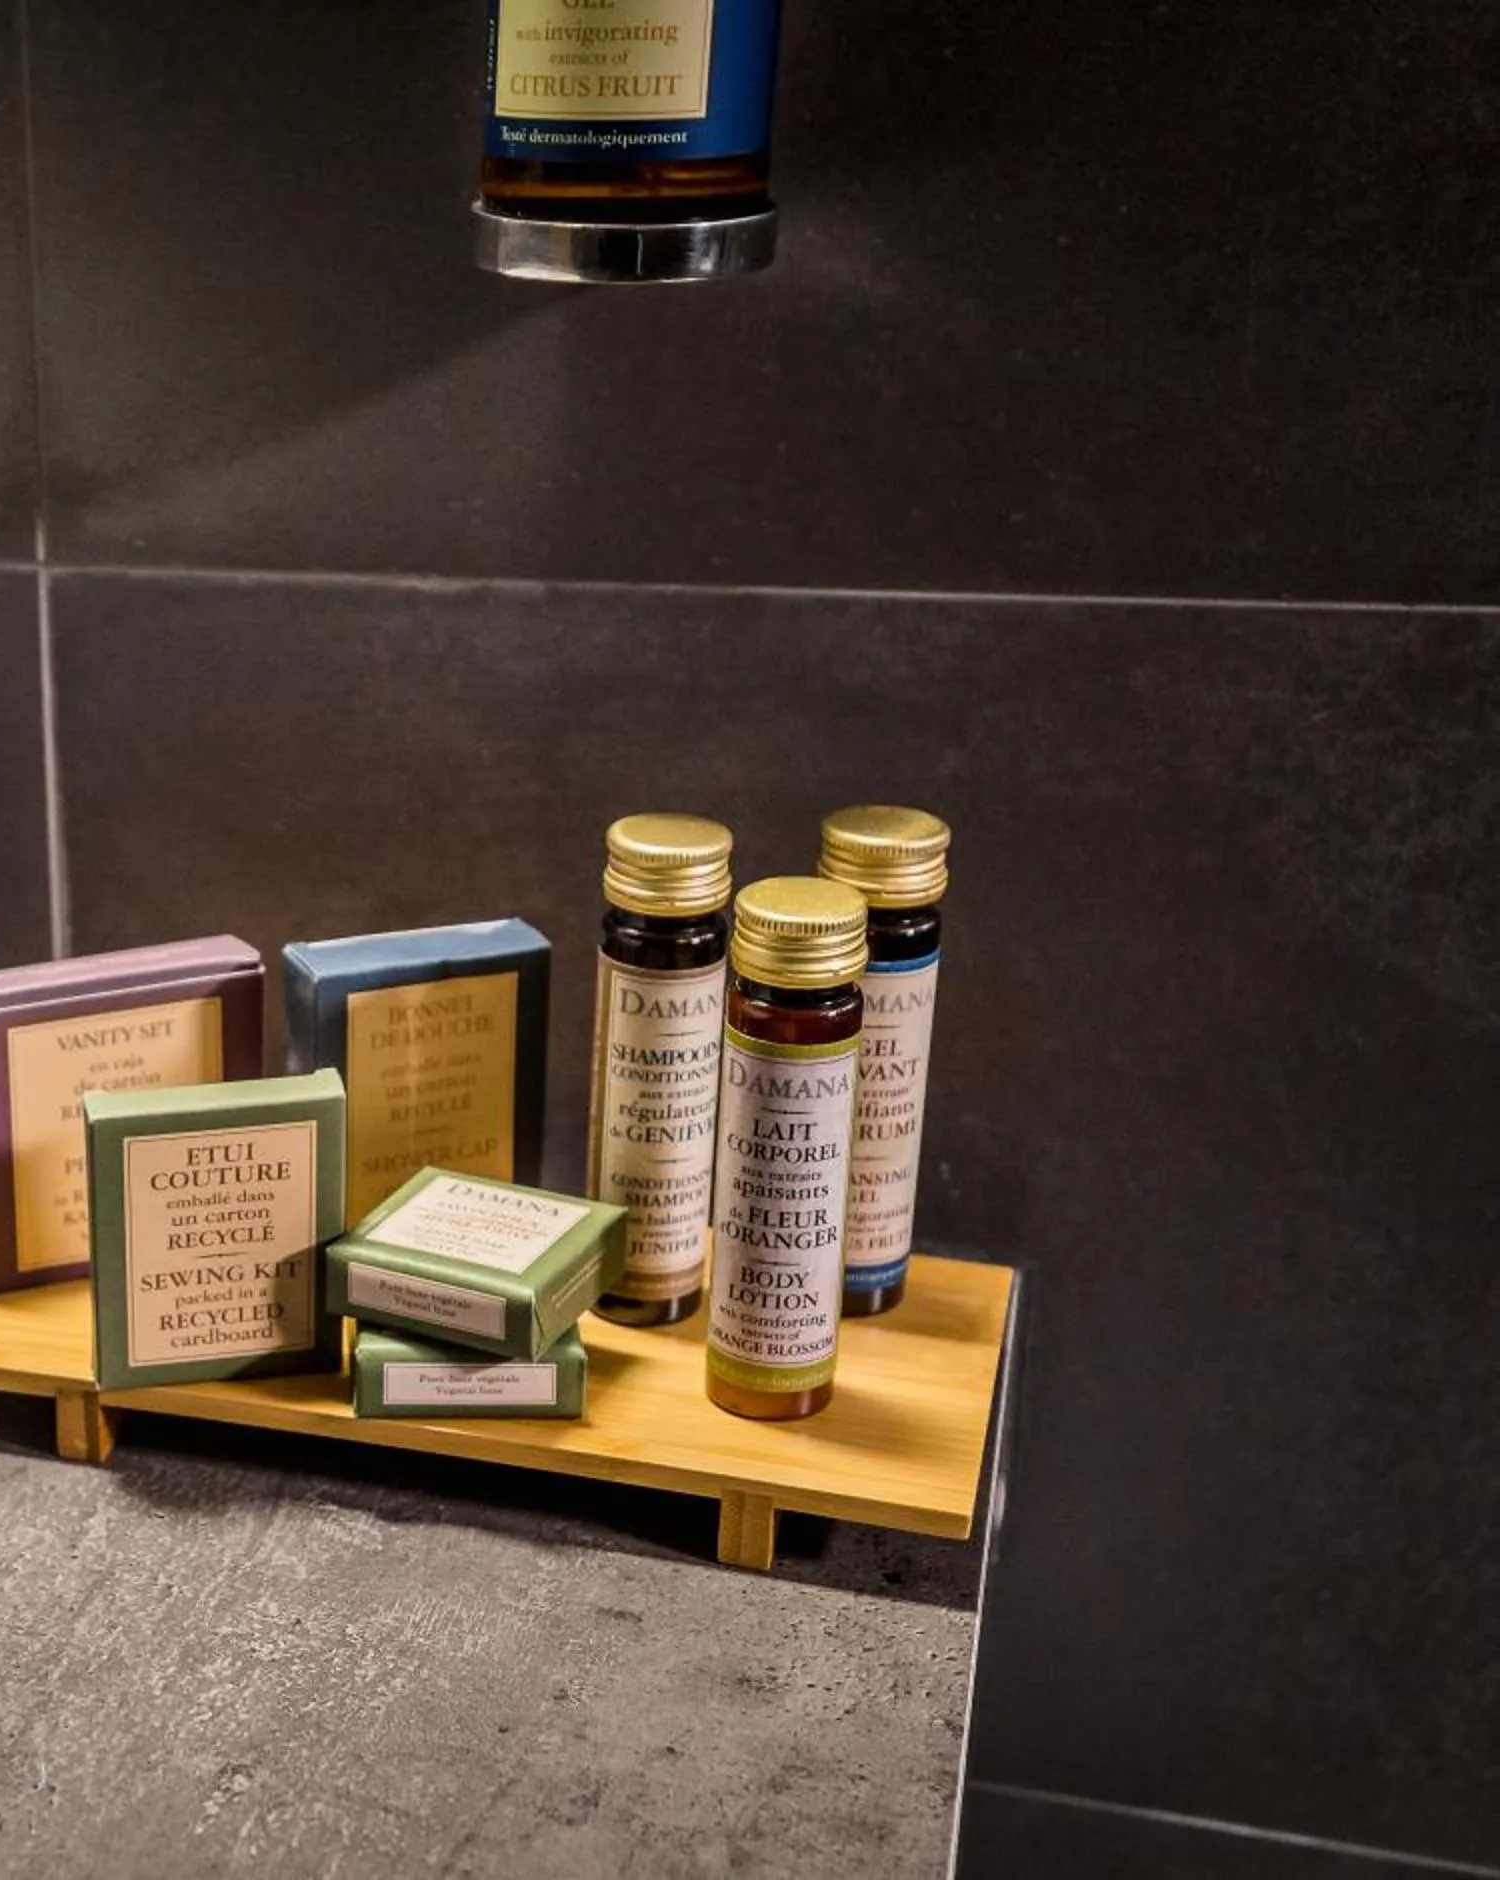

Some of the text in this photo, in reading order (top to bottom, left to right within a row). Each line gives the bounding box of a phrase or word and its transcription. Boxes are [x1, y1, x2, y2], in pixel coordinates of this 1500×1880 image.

[545, 21, 679, 47] invigorating
[611, 50, 628, 64] of
[510, 73, 683, 97] CITRUS FRUIT
[529, 127, 689, 149] dermatologiquement
[619, 987, 720, 1019] DAMAN
[866, 987, 933, 1014] MANA
[56, 1019, 175, 1051] VANITY SET
[729, 1057, 850, 1099] DAMANA
[858, 1057, 921, 1082] VANT
[858, 1102, 916, 1120] ifiants
[752, 1118, 818, 1141] LAIT
[186, 1142, 256, 1167] ETUI
[727, 1132, 842, 1165] CORPOREL
[150, 1161, 292, 1191] COUTURE
[732, 1176, 830, 1201] apaisants
[850, 1166, 912, 1187] ANSING
[166, 1189, 276, 1210] emballé dans
[171, 1207, 271, 1227] un carton
[748, 1205, 828, 1229] FLEUR
[166, 1221, 276, 1251] RECYCLÉ
[140, 1260, 304, 1293] SEWING KIT
[740, 1265, 811, 1289] BODY
[175, 1286, 268, 1309] packed in a
[728, 1283, 820, 1311] LOTION
[159, 1301, 286, 1331] RECYCLED
[740, 1312, 828, 1330] comforting
[170, 1322, 275, 1348] cardboard
